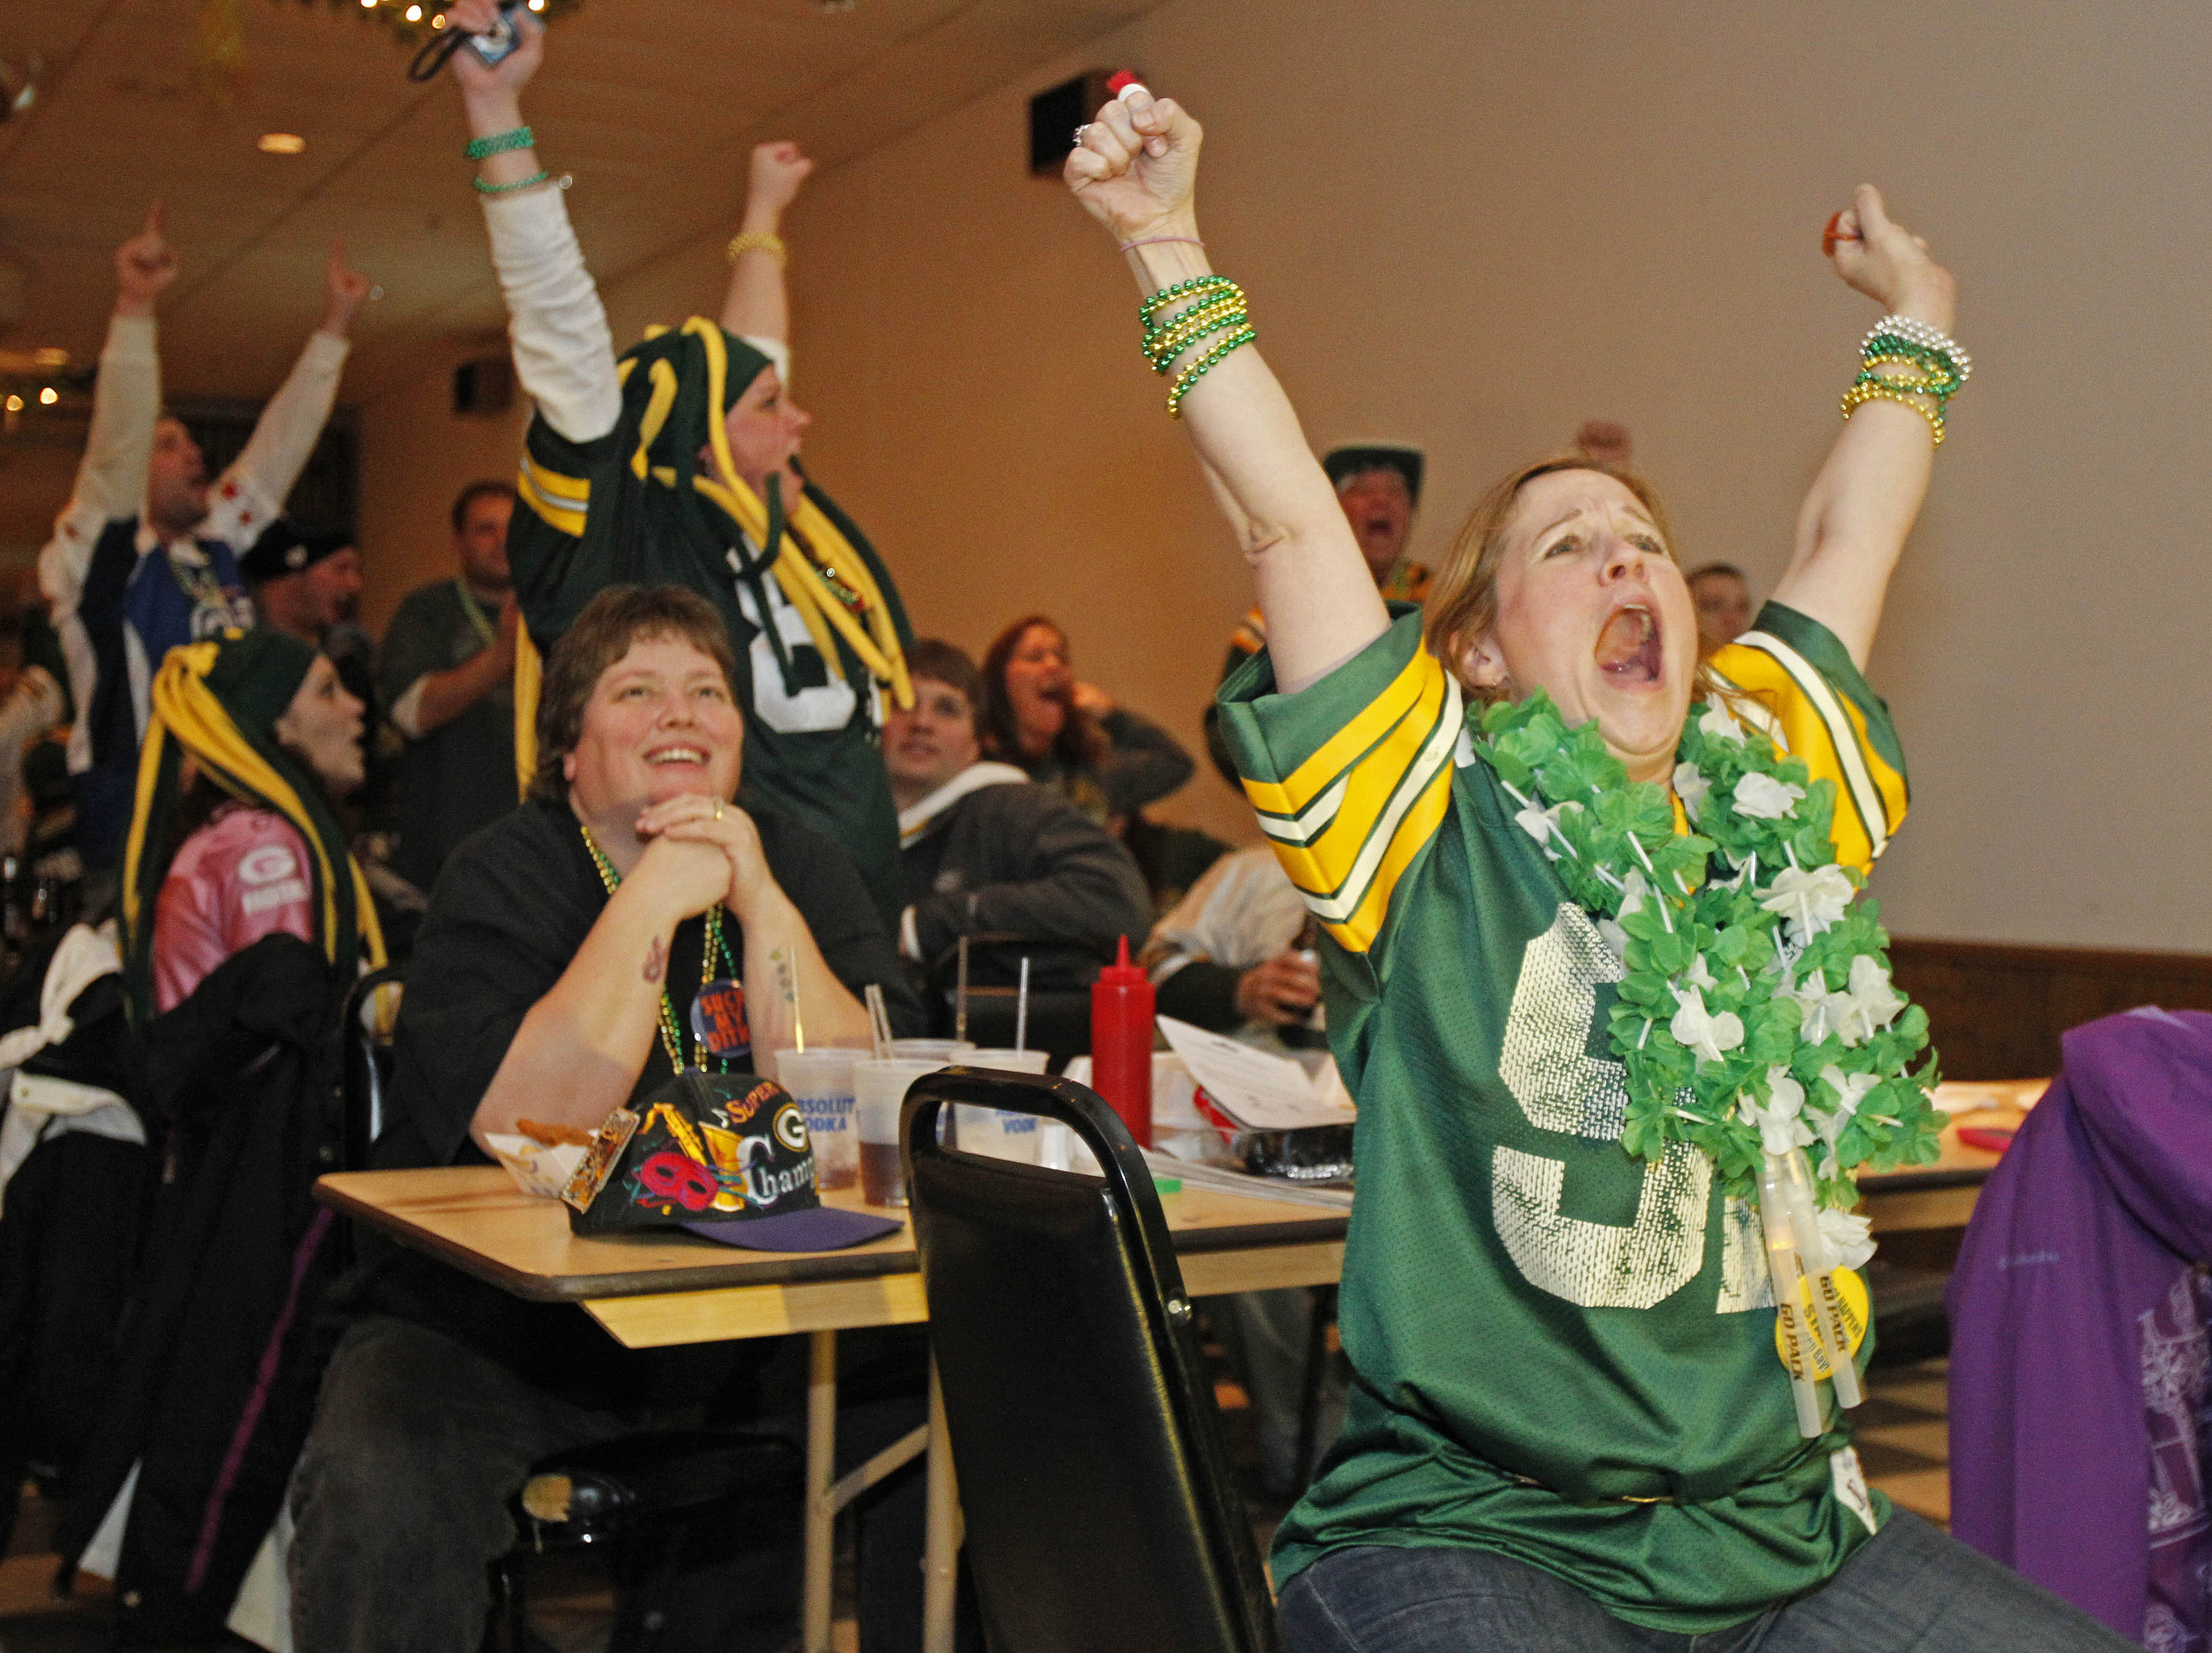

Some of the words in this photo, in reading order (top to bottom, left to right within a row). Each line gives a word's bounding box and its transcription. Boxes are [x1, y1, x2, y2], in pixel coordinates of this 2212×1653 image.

[796, 1096, 855, 1114] BSOLUT
[775, 1107, 807, 1149] G
[804, 1116, 847, 1131] ODKA
